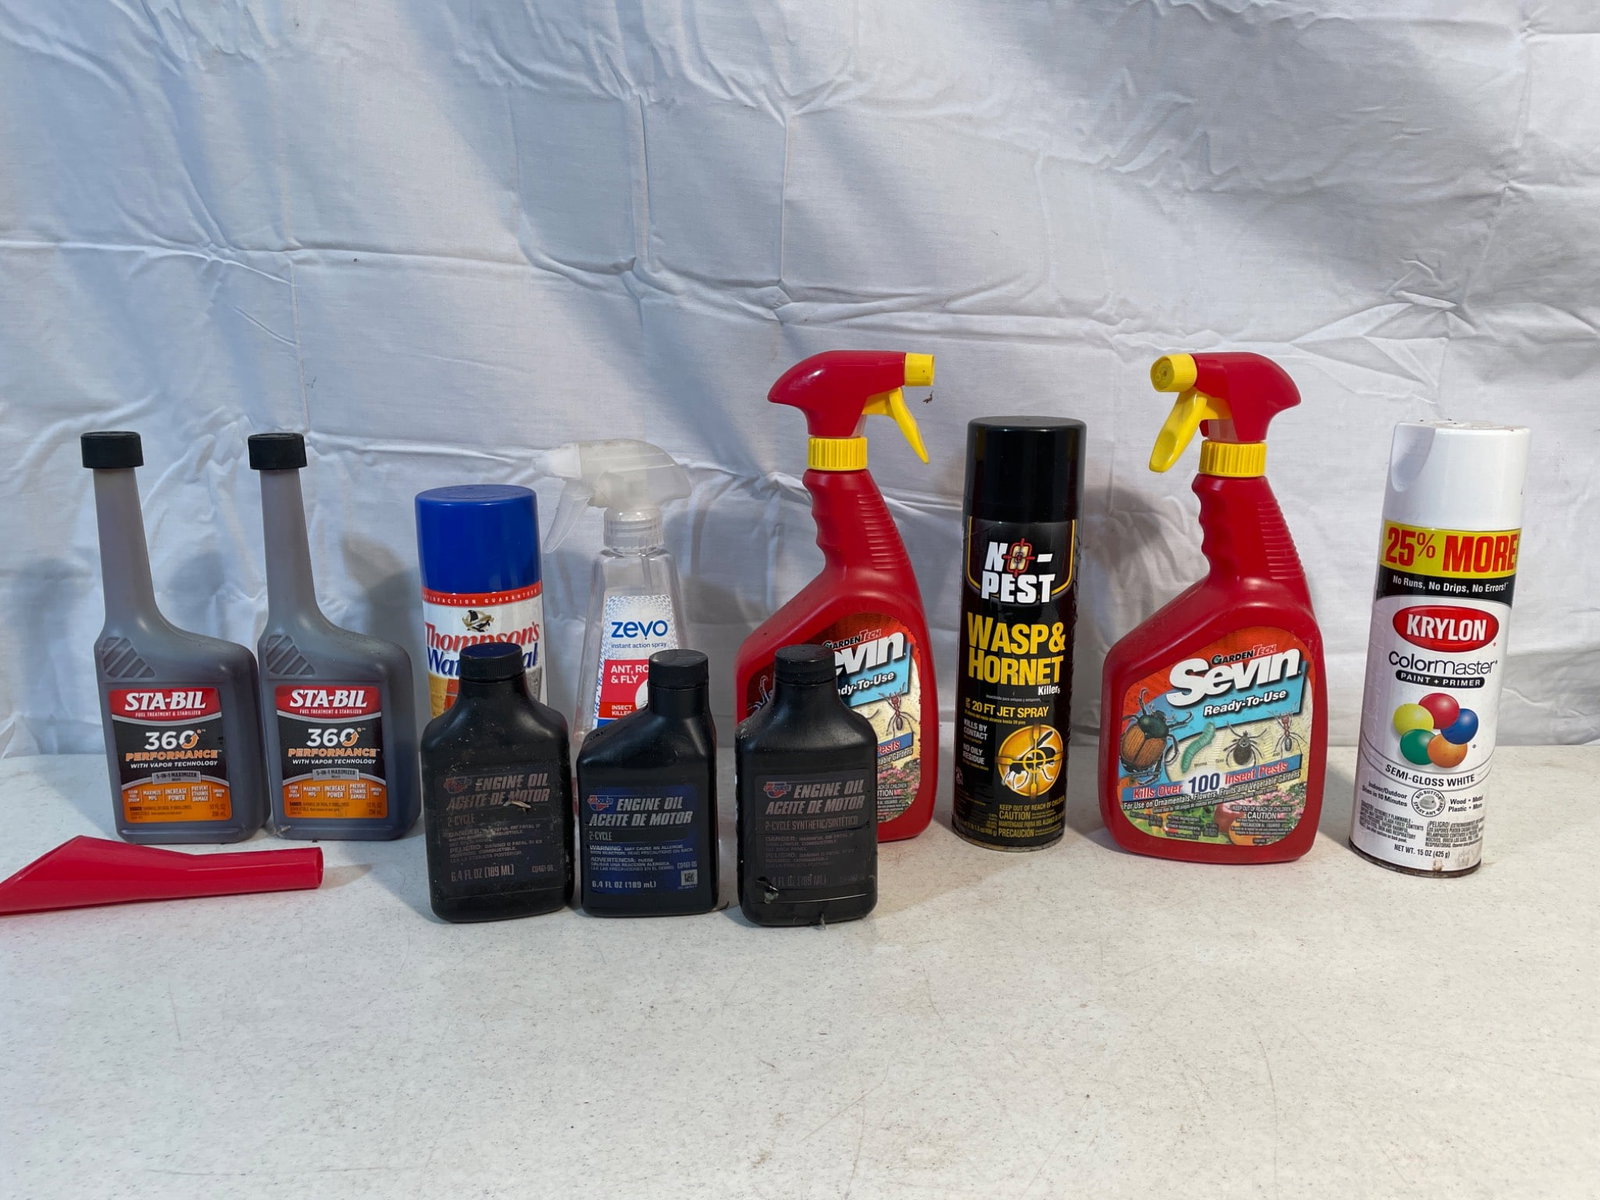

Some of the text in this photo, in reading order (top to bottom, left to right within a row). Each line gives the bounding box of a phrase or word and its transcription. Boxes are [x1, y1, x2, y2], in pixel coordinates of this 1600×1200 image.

[1385, 527, 1519, 573] 25% MORE
[981, 570, 1056, 604] PEST
[1392, 575, 1507, 594] No Runs, No Drips, No Errors!
[611, 620, 668, 638] zevo
[1406, 614, 1487, 641] KRYLON
[611, 665, 633, 674] ANT,
[968, 648, 1064, 686] HORNET
[611, 675, 639, 684] & FLY
[1166, 648, 1300, 707] Sevin
[1400, 673, 1431, 684] PAINT
[124, 691, 207, 711] STA-BIL
[290, 689, 368, 708] STA-BIL
[1203, 689, 1287, 718] Ready-To-Use
[972, 700, 983, 712] 20
[984, 703, 996, 715] FT
[997, 706, 1016, 718] JET
[1017, 706, 1049, 718] SPRAY
[964, 718, 988, 733] KILLS BY
[964, 726, 988, 741] CONTACT
[476, 773, 549, 792] ENGINE OIL
[1133, 762, 1288, 799] Kills Over 100 Insect Pests
[1219, 788, 1236, 797] Fruits
[1248, 778, 1278, 791] Vegetable
[1278, 770, 1301, 783] Gardens
[1386, 764, 1475, 787] SEMI-GLOSS WHITE
[794, 780, 865, 799] ENGINE OIL
[447, 789, 551, 810] ACEITE DE MOTOR
[616, 796, 684, 812] ENGINE OIL
[765, 801, 806, 815] ACEITE
[807, 800, 822, 814] DE
[824, 795, 866, 813] MOTOR
[1384, 796, 1408, 807] Minutes
[589, 811, 694, 827] ACEITE DE MOTOR
[999, 811, 1031, 820] CAUTION
[589, 831, 613, 841] 2-CYCLE
[1394, 845, 1405, 853] NET
[1405, 846, 1416, 854] WT.
[1425, 849, 1432, 857] OZ
